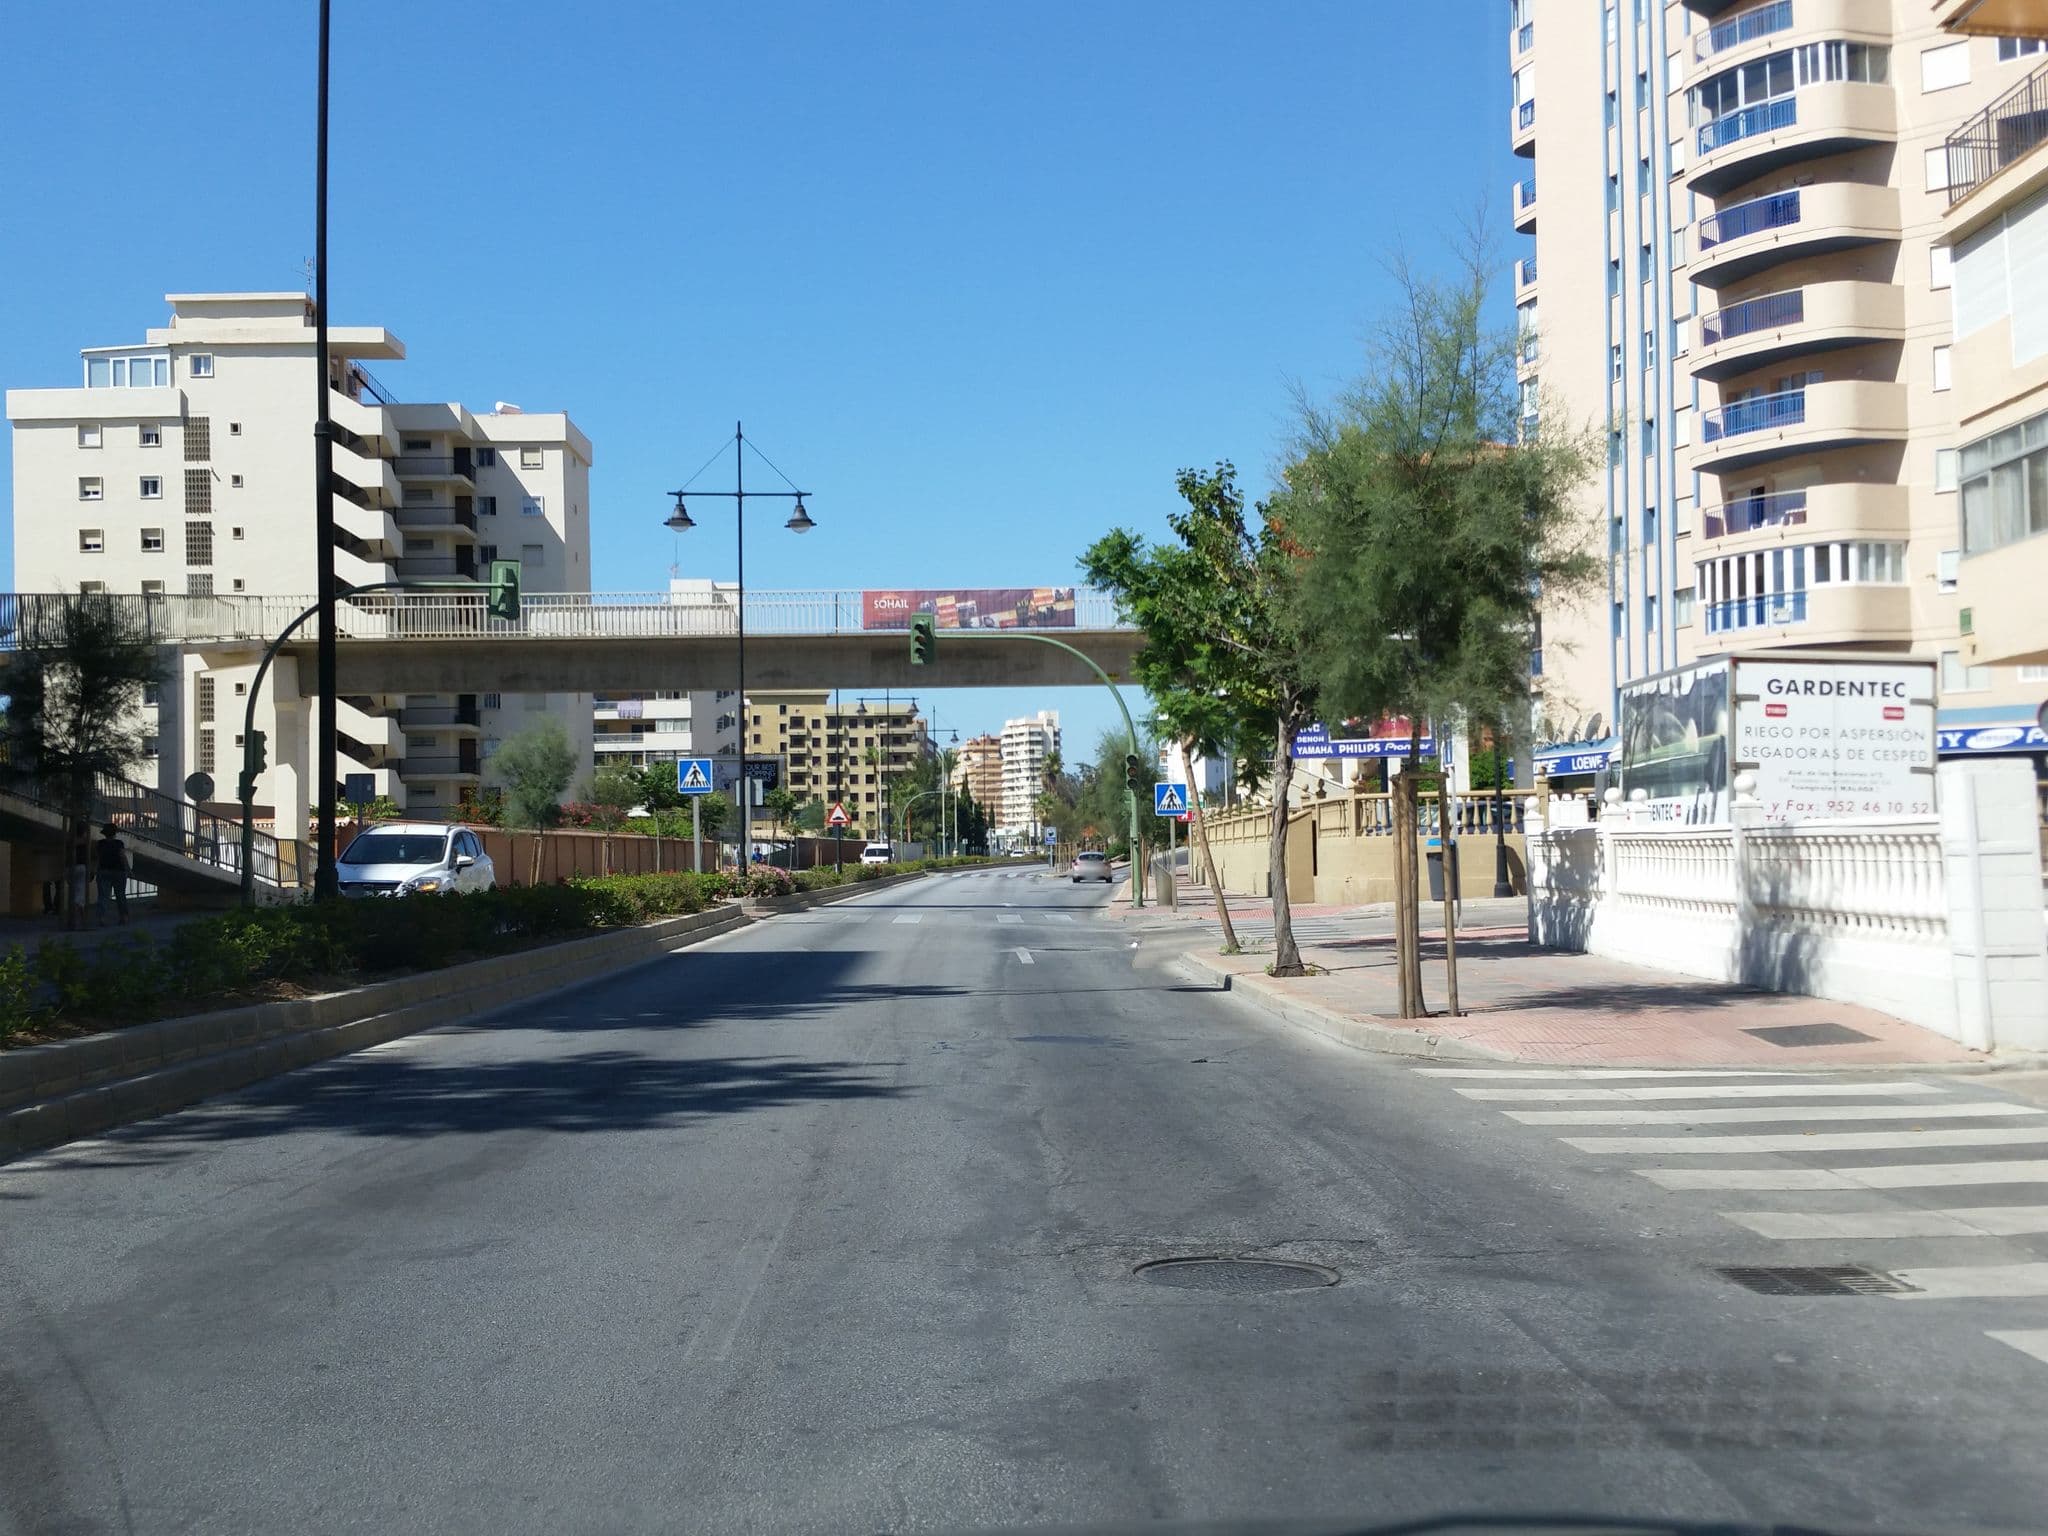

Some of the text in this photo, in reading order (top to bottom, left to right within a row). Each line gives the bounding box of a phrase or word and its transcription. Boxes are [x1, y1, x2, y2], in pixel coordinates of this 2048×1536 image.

[873, 599, 909, 609] SOHAIL
[1767, 678, 1906, 698] GARDENTEC
[1744, 726, 1793, 739] RIEGO
[1799, 727, 1831, 740] POR
[1296, 742, 1432, 755] YAMAHA PHILIPS Pioner
[1742, 746, 1929, 763] SEGADORAS DE CESPED
[1571, 755, 1604, 771] LOEWE
[1827, 801, 1855, 812] 952
[1862, 802, 1881, 813] 46
[1887, 802, 1903, 813] 10
[1911, 803, 1930, 814] 52
